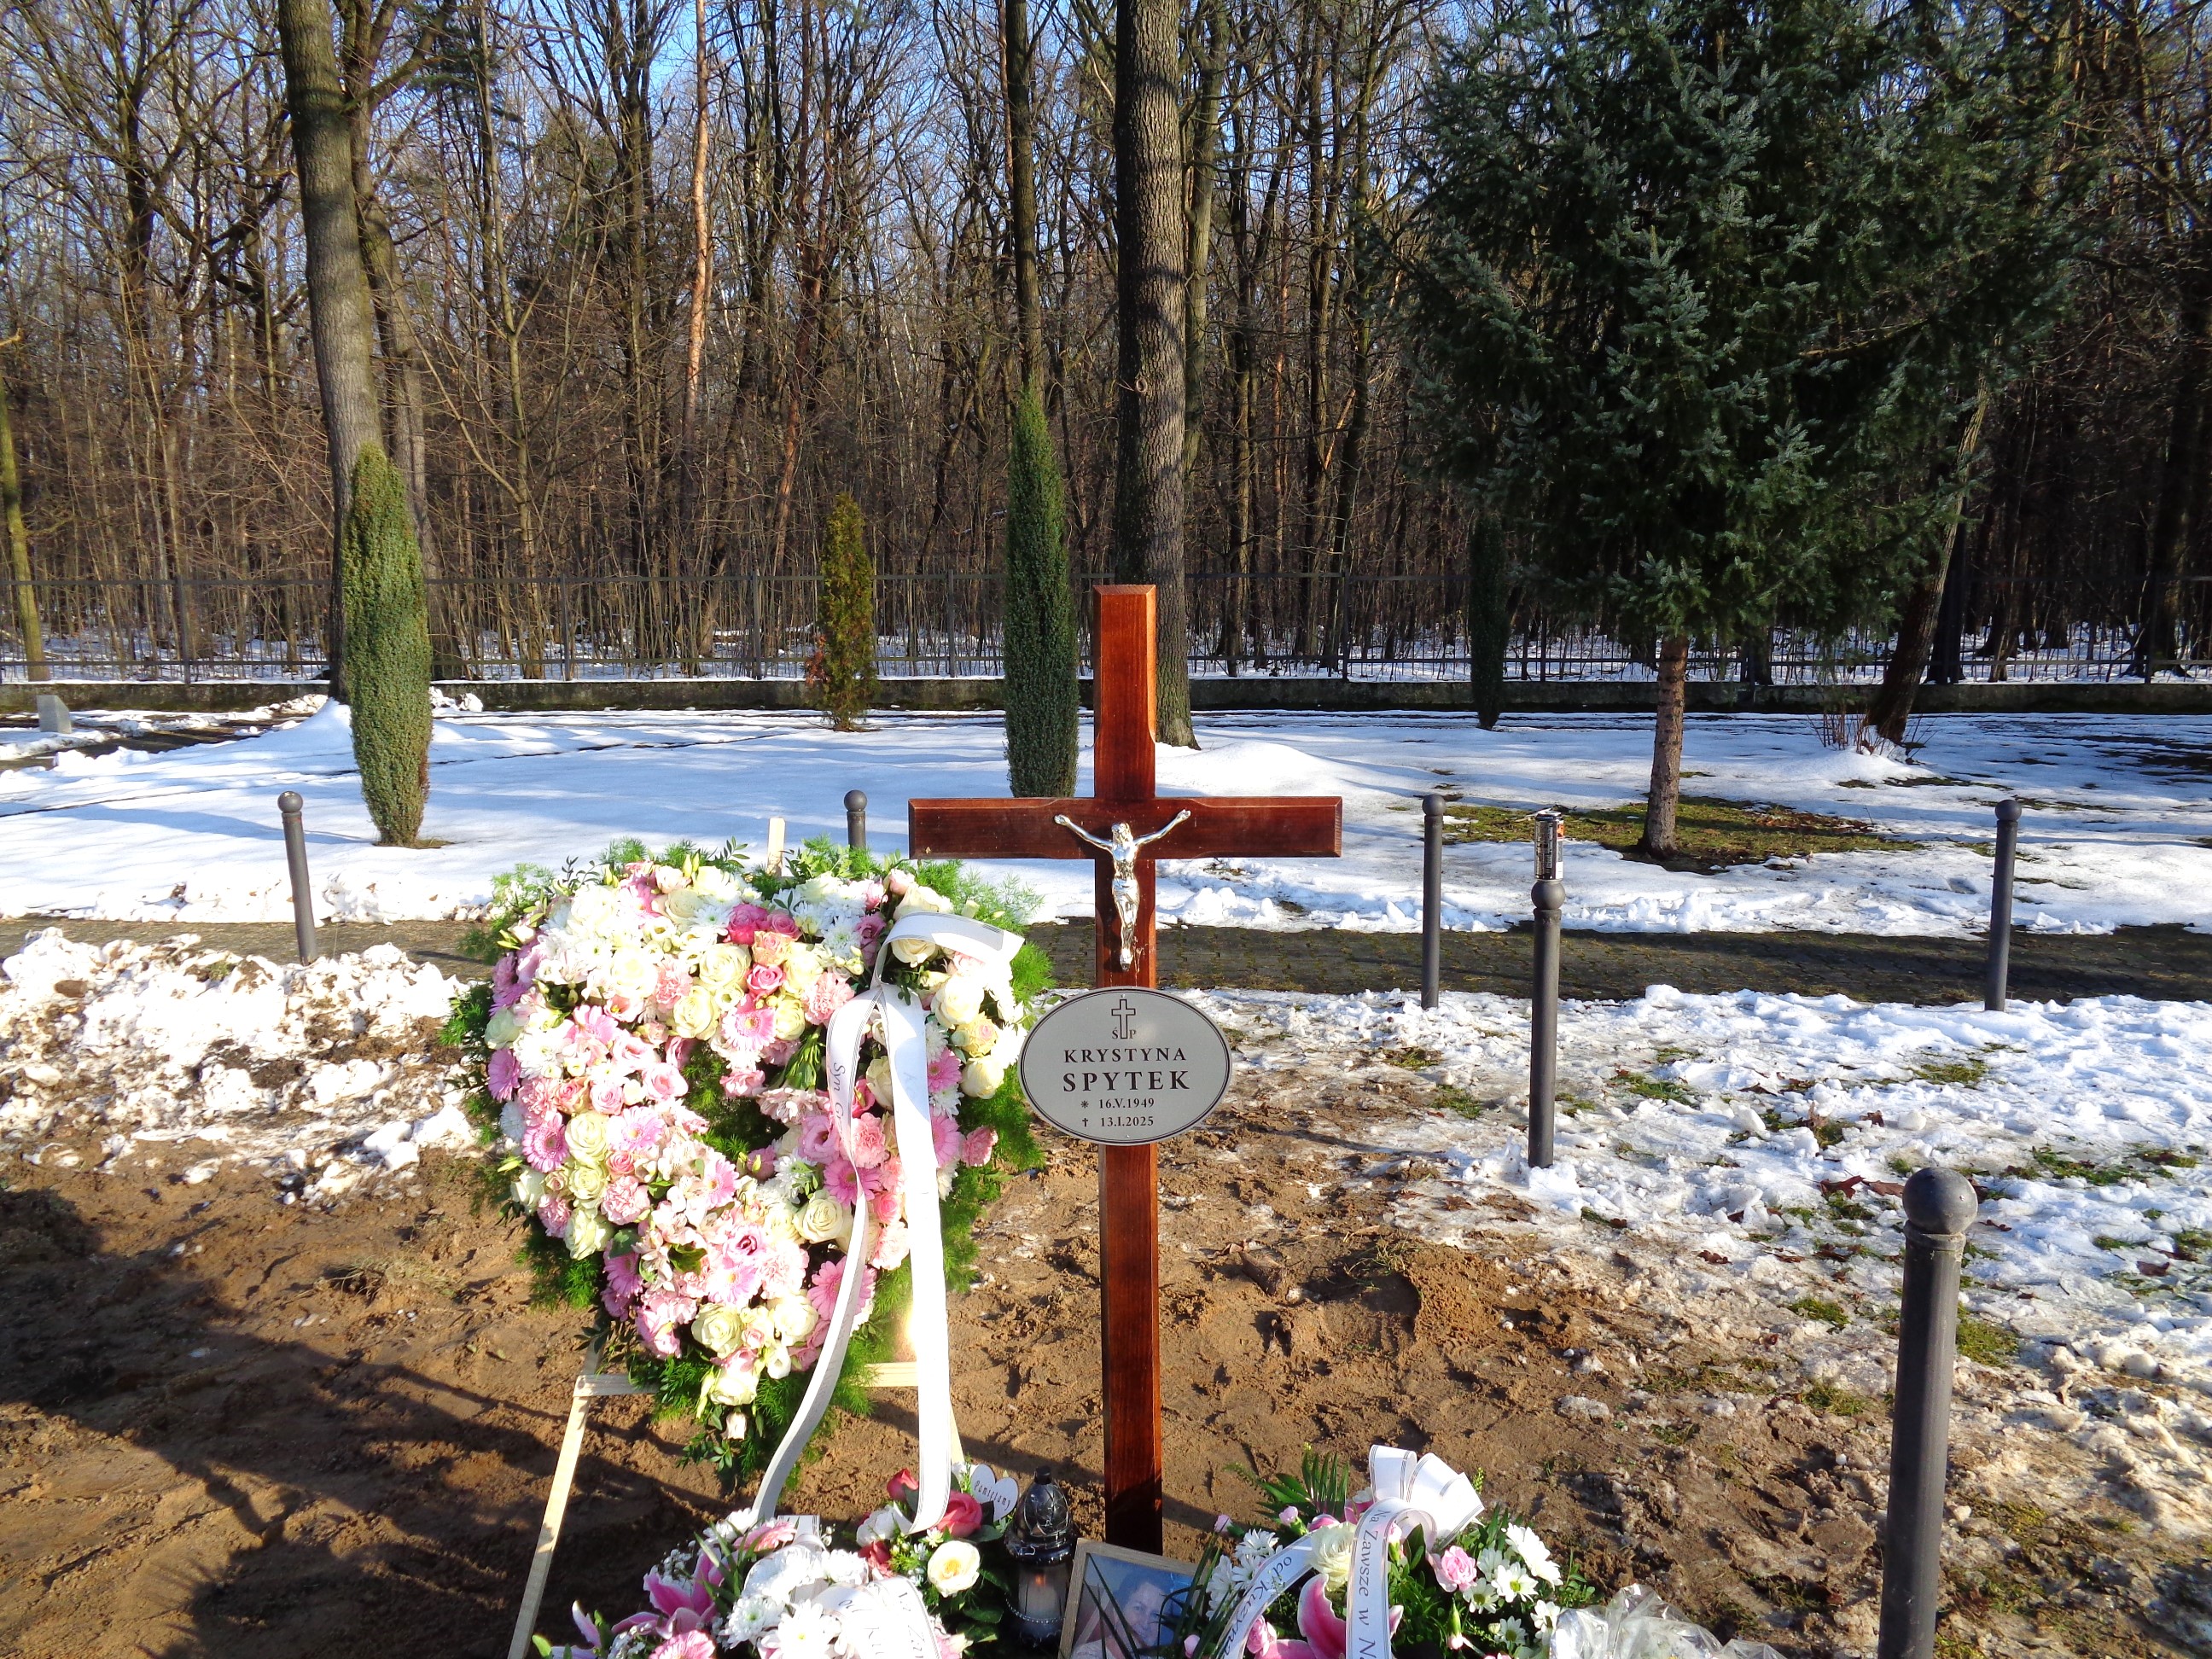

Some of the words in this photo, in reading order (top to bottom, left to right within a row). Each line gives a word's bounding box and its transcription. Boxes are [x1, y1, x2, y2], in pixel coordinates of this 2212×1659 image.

[1063, 1047, 1187, 1063] KRYSTYNA
[830, 1062, 846, 1091] Syn
[1062, 1070, 1190, 1092] SPYTEK
[1098, 1097, 1155, 1109] 16.V.1949
[1100, 1116, 1154, 1127] 13.I.2025
[1369, 1510, 1391, 1523] Na
[1359, 1529, 1379, 1598] Zawsze
[1359, 1608, 1369, 1625] w
